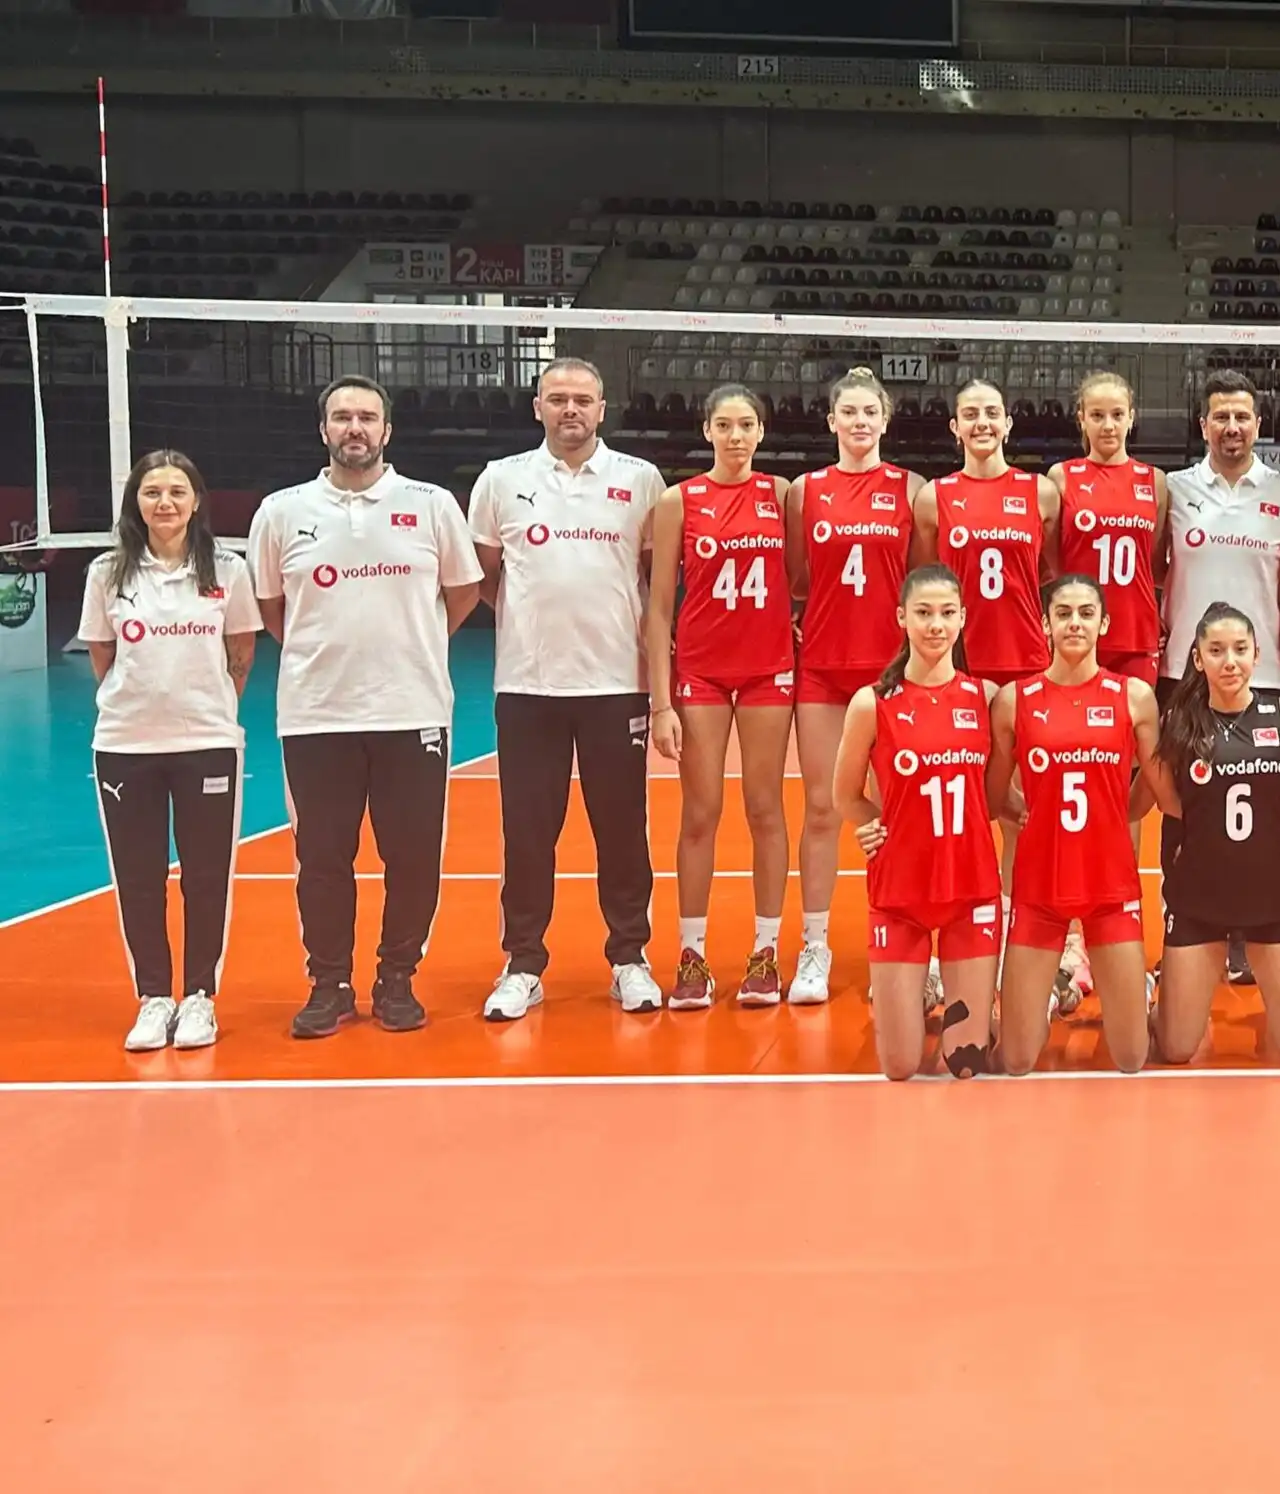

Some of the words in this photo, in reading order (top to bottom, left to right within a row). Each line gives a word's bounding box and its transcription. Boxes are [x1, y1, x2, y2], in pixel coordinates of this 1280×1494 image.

[741, 57, 775, 74] 215
[455, 248, 478, 282] 2
[480, 269, 520, 283] KAPI
[456, 352, 491, 370] 118
[886, 358, 922, 379] 117
[834, 521, 899, 537] vodafone
[1099, 514, 1155, 532] vodafone
[552, 527, 621, 545] vodafone
[720, 534, 783, 550] vodafone
[971, 526, 1032, 544] vodafone
[1208, 532, 1270, 550] vodafone
[1093, 534, 1137, 587] 10
[340, 562, 412, 580] vodafone
[841, 543, 867, 597] 4
[979, 547, 1004, 600] 8
[712, 555, 768, 610] 44
[149, 620, 217, 638] vodafone
[921, 748, 985, 766] vodafone
[1052, 747, 1120, 764] vodafone
[919, 774, 966, 837] 11
[1060, 771, 1088, 833] 5
[1225, 783, 1253, 842] 6
[1167, 915, 1175, 934] 6
[873, 926, 887, 947] 11
